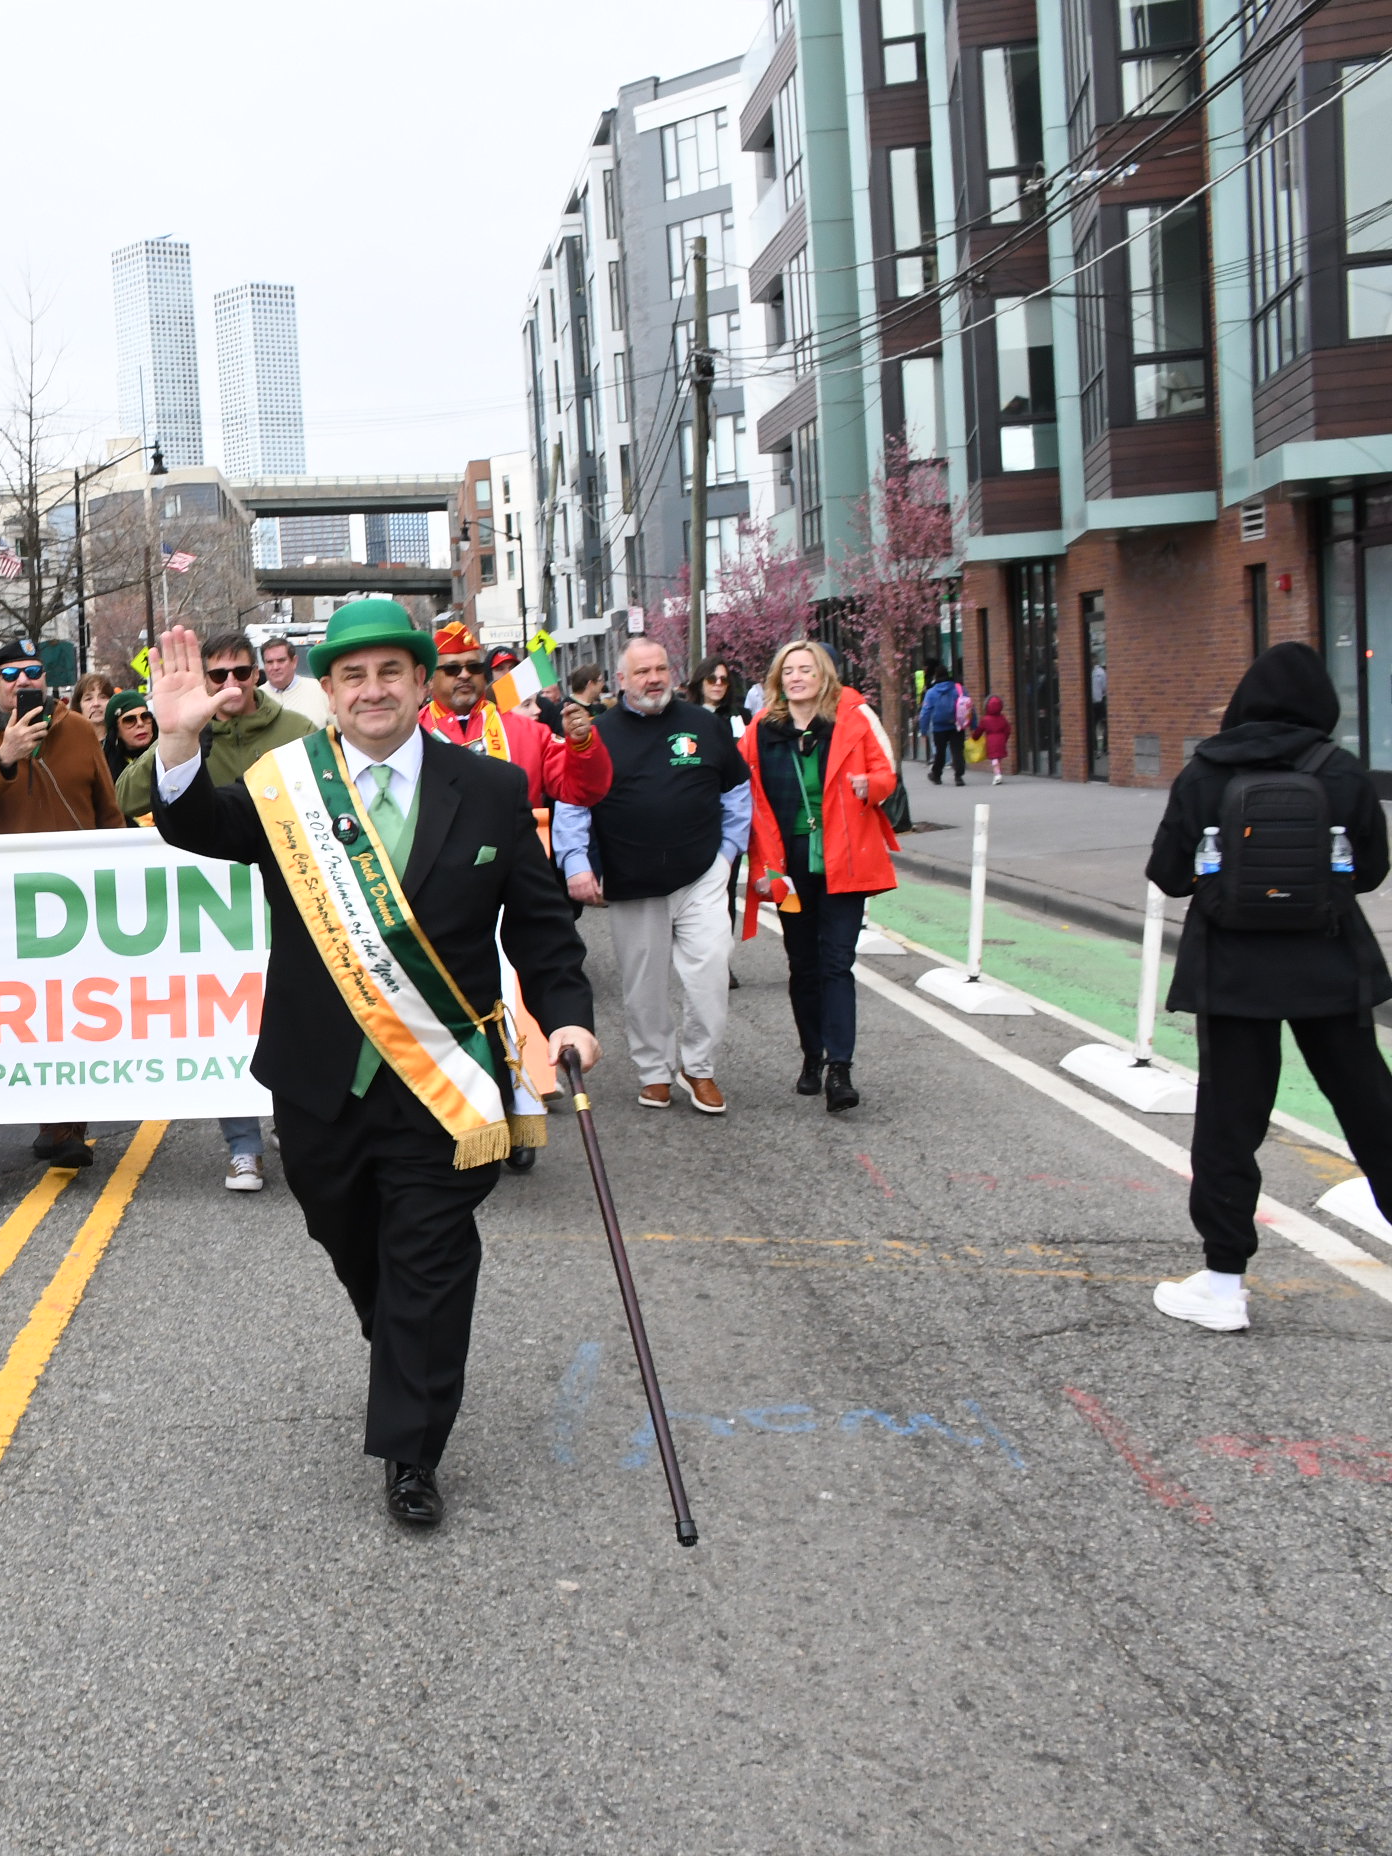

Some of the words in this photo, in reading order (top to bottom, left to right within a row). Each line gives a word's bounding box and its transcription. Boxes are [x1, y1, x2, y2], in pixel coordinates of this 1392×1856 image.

[305, 810, 334, 851] 2024
[324, 855, 357, 917] Irishman
[350, 852, 381, 882] Jack
[370, 882, 395, 927] Dunne
[14, 864, 271, 959] DUN
[275, 820, 297, 849] Jersey
[292, 853, 309, 874] City
[337, 942, 352, 968] Day
[349, 967, 378, 1006] Parade
[351, 921, 370, 935] of
[360, 939, 380, 958] the
[369, 957, 400, 993] Year
[176, 1056, 248, 1082] DAY
